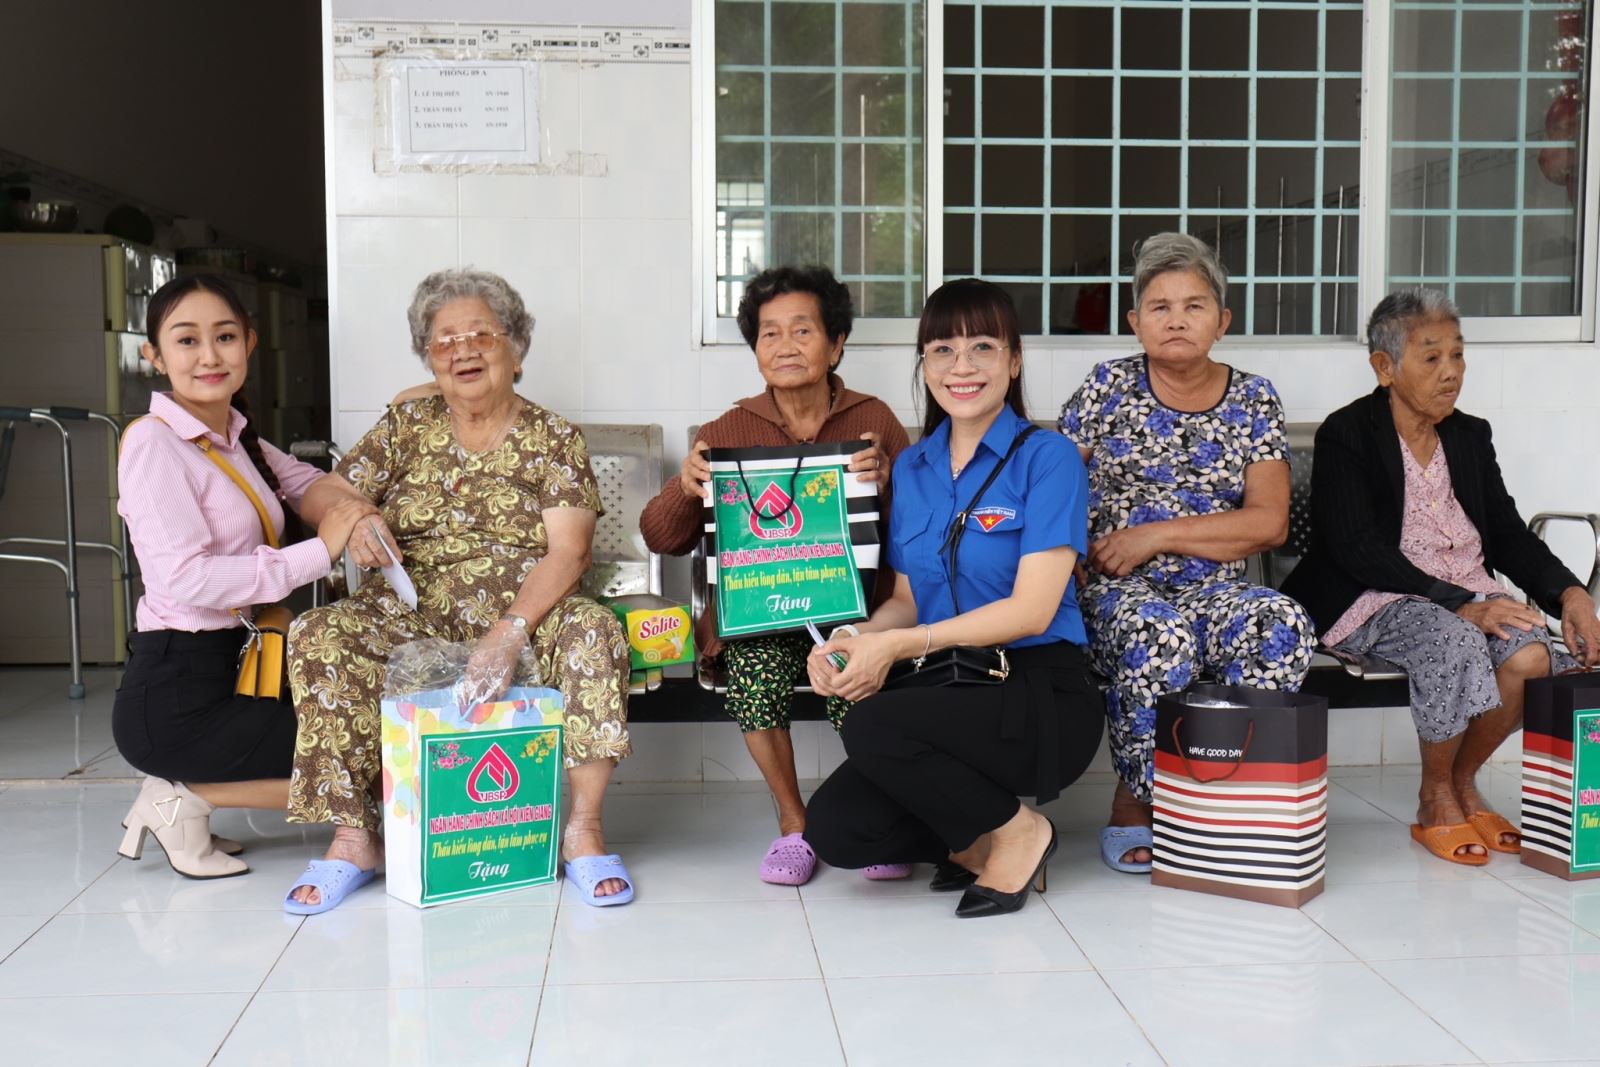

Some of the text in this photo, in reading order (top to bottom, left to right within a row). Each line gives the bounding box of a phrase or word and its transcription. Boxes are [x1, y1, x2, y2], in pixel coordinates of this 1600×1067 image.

[766, 594, 812, 615] Tặng
[640, 616, 680, 639] Solite
[1188, 746, 1243, 758] HAVE GOOD DAY
[430, 814, 448, 834] NGÂN
[448, 812, 465, 832] HÀNG
[484, 807, 500, 828] SÁCH
[519, 803, 534, 823] KIÊN
[534, 804, 552, 821] GIANG
[467, 837, 482, 856] lòng
[468, 861, 510, 881] Tặng
